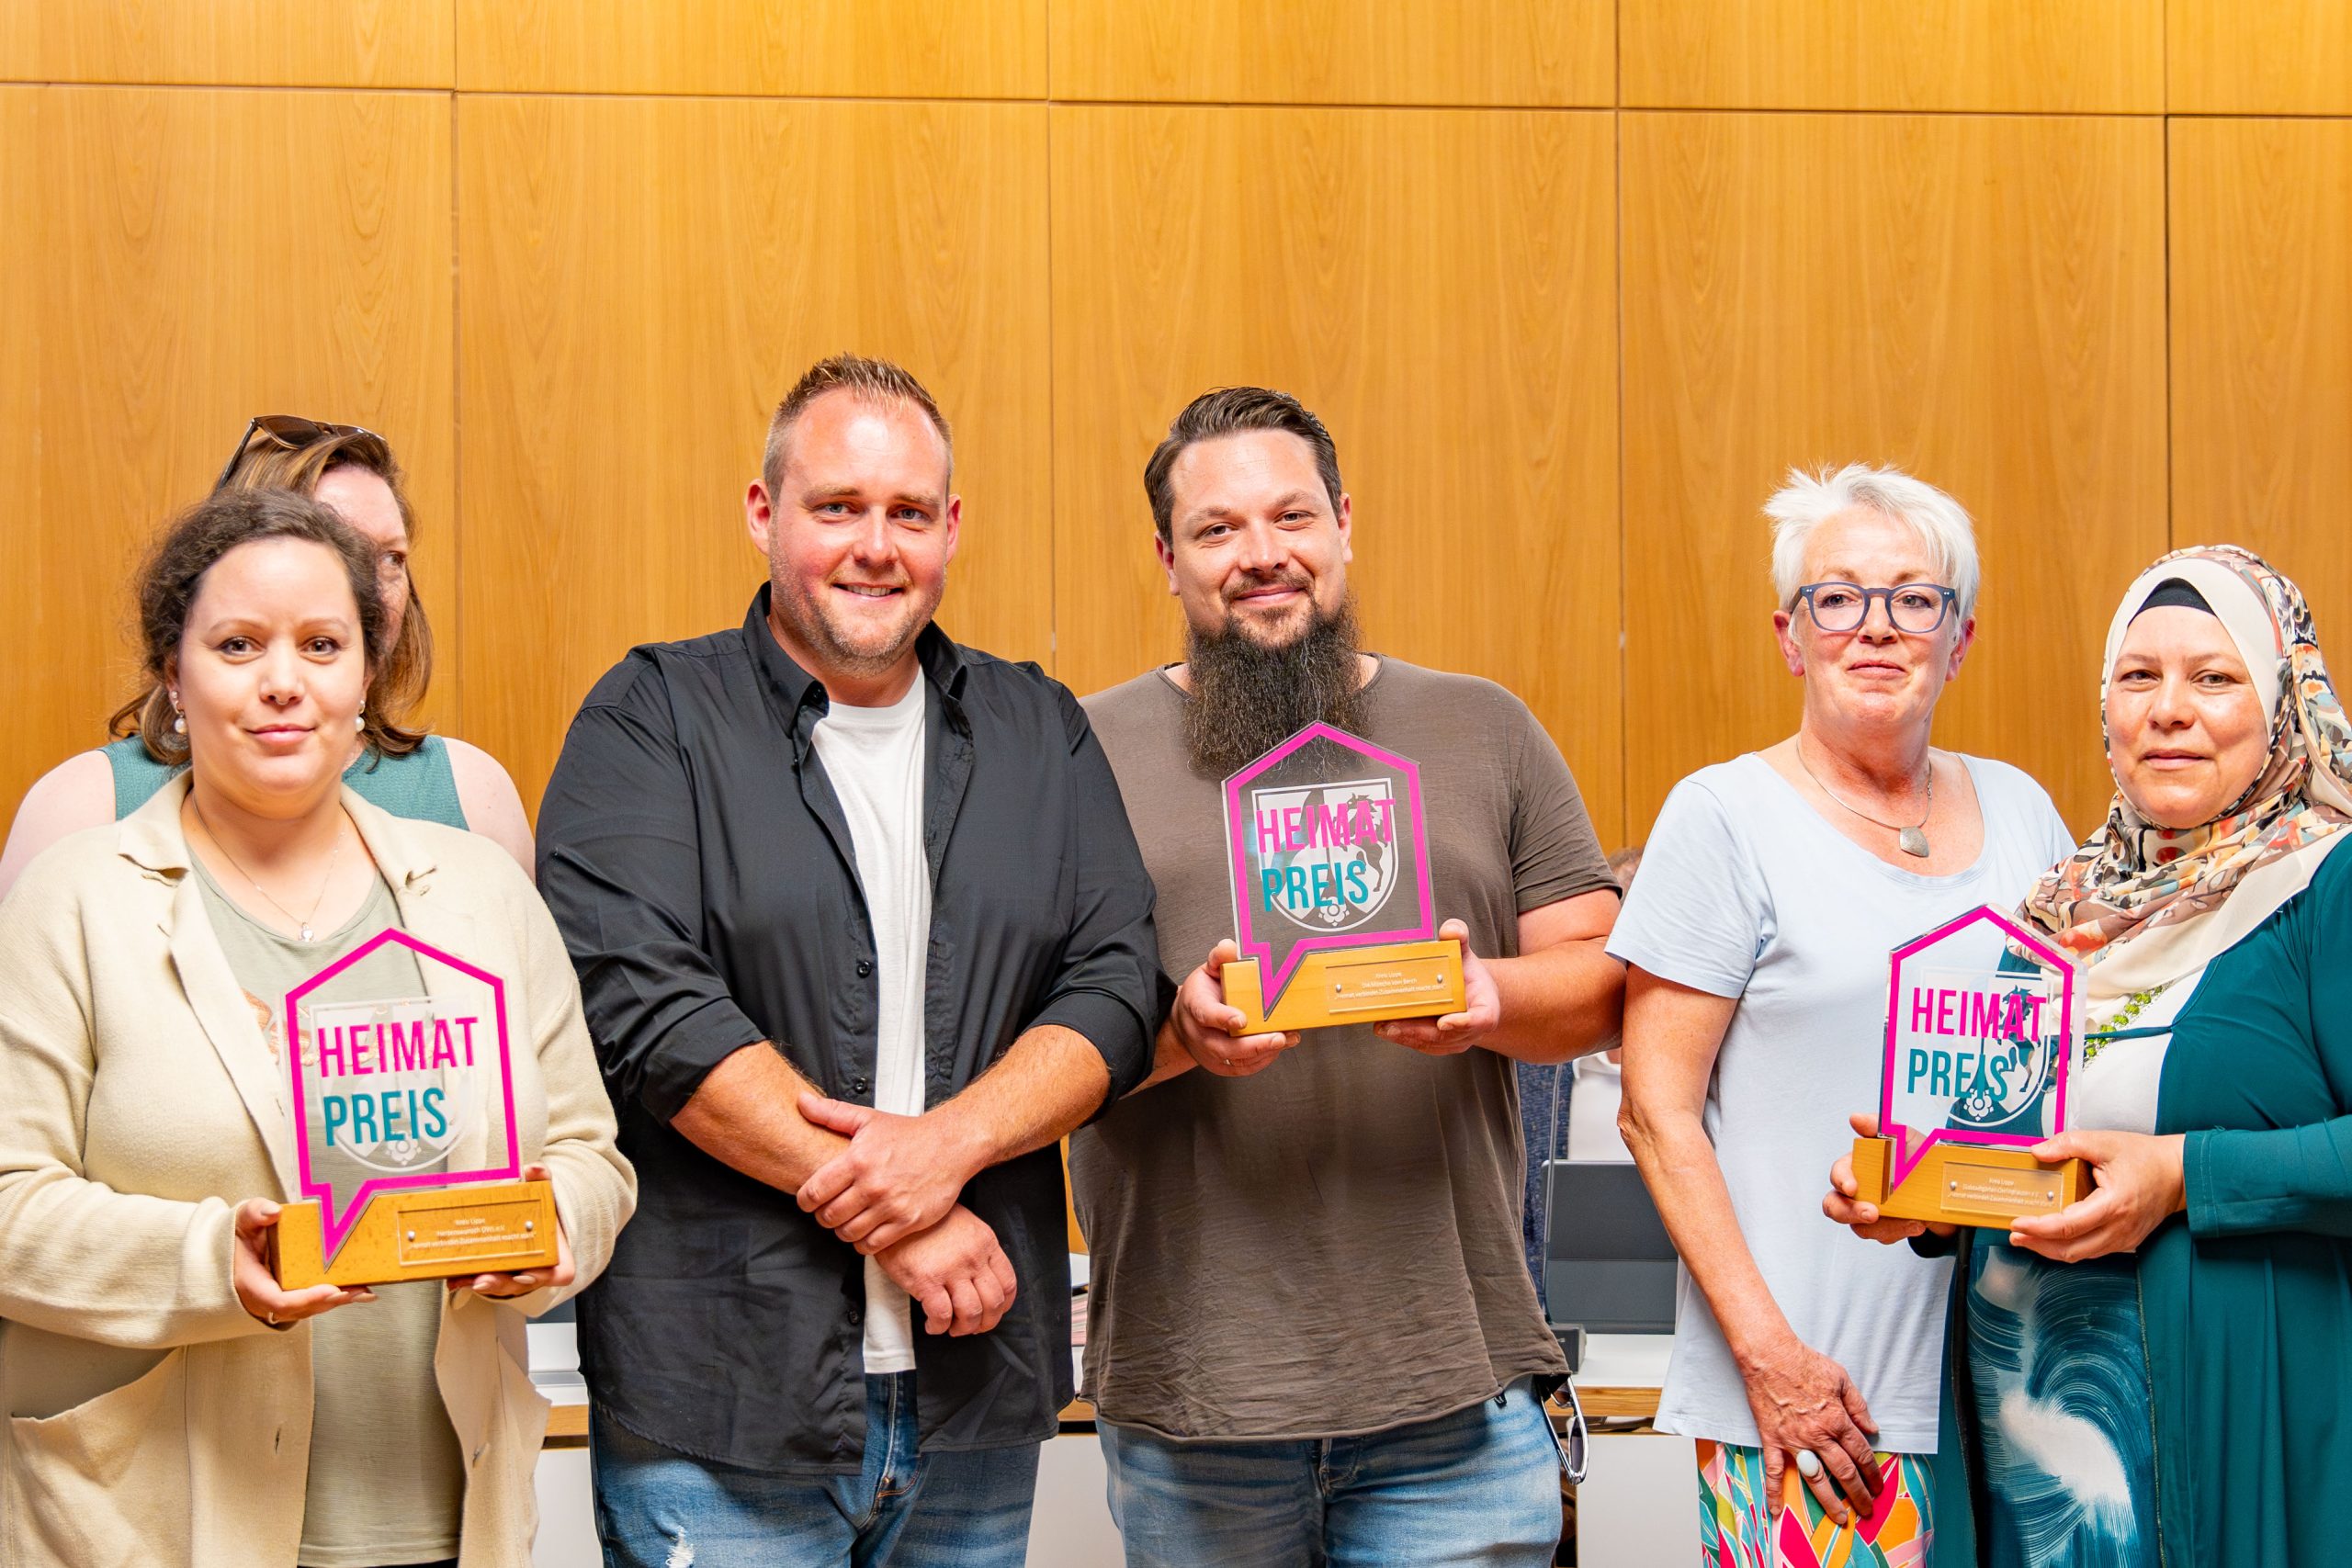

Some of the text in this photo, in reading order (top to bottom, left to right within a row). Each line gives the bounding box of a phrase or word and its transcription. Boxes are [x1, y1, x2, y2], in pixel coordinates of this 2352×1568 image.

[1256, 798, 1396, 853] HEIMAT
[1261, 861, 1370, 912] PREIS
[1911, 987, 2049, 1043] HEIMAT
[317, 1016, 479, 1078] HEIMAT
[1907, 1048, 2010, 1102] PREIS
[322, 1087, 448, 1146] PREIS
